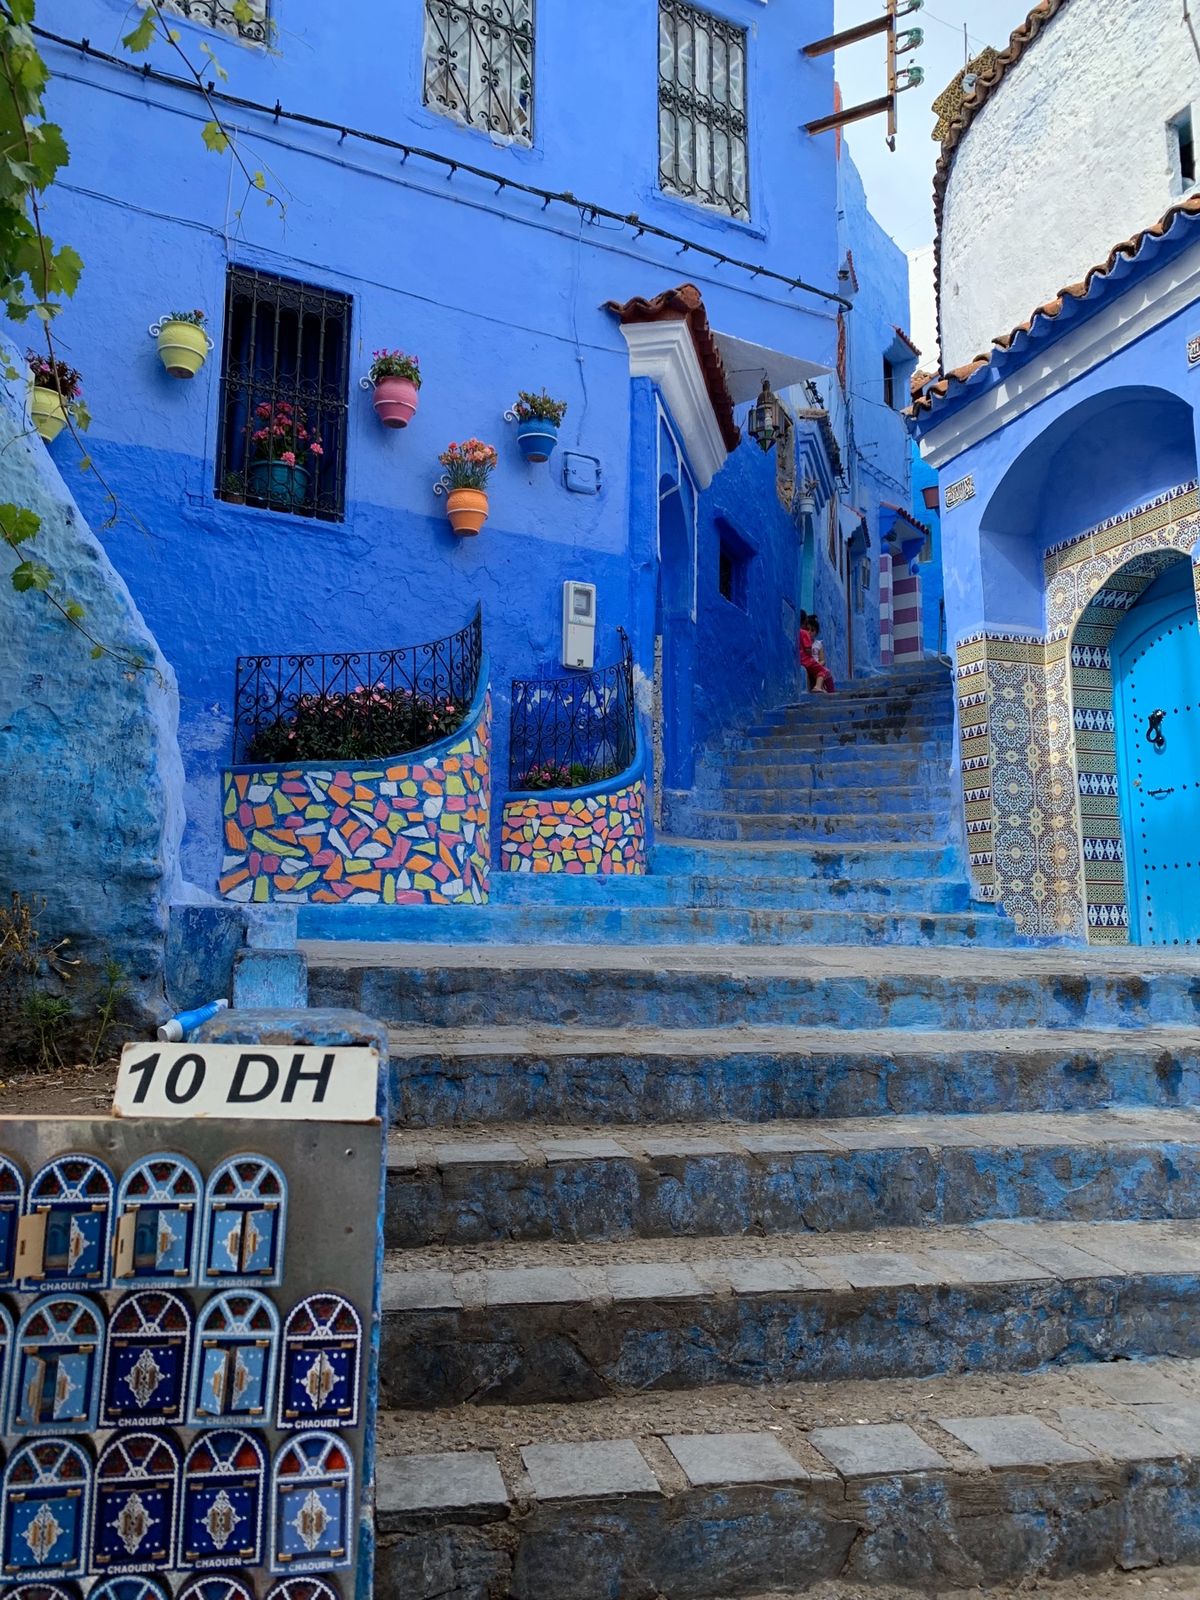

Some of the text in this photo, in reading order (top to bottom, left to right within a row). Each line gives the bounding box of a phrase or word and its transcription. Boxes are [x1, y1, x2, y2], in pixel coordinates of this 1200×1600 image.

[128, 1053, 336, 1104] 10 DH
[40, 1282, 89, 1291] CHAOUEN
[118, 1416, 166, 1427] CHAOUEN
[294, 1418, 340, 1429] CHAOUEN
[195, 1557, 242, 1568] CHAOUEN
[288, 1561, 334, 1572] CHAOUEN
[107, 1563, 156, 1574] CHAOUEN
[16, 1569, 66, 1581] CHAOUEN
